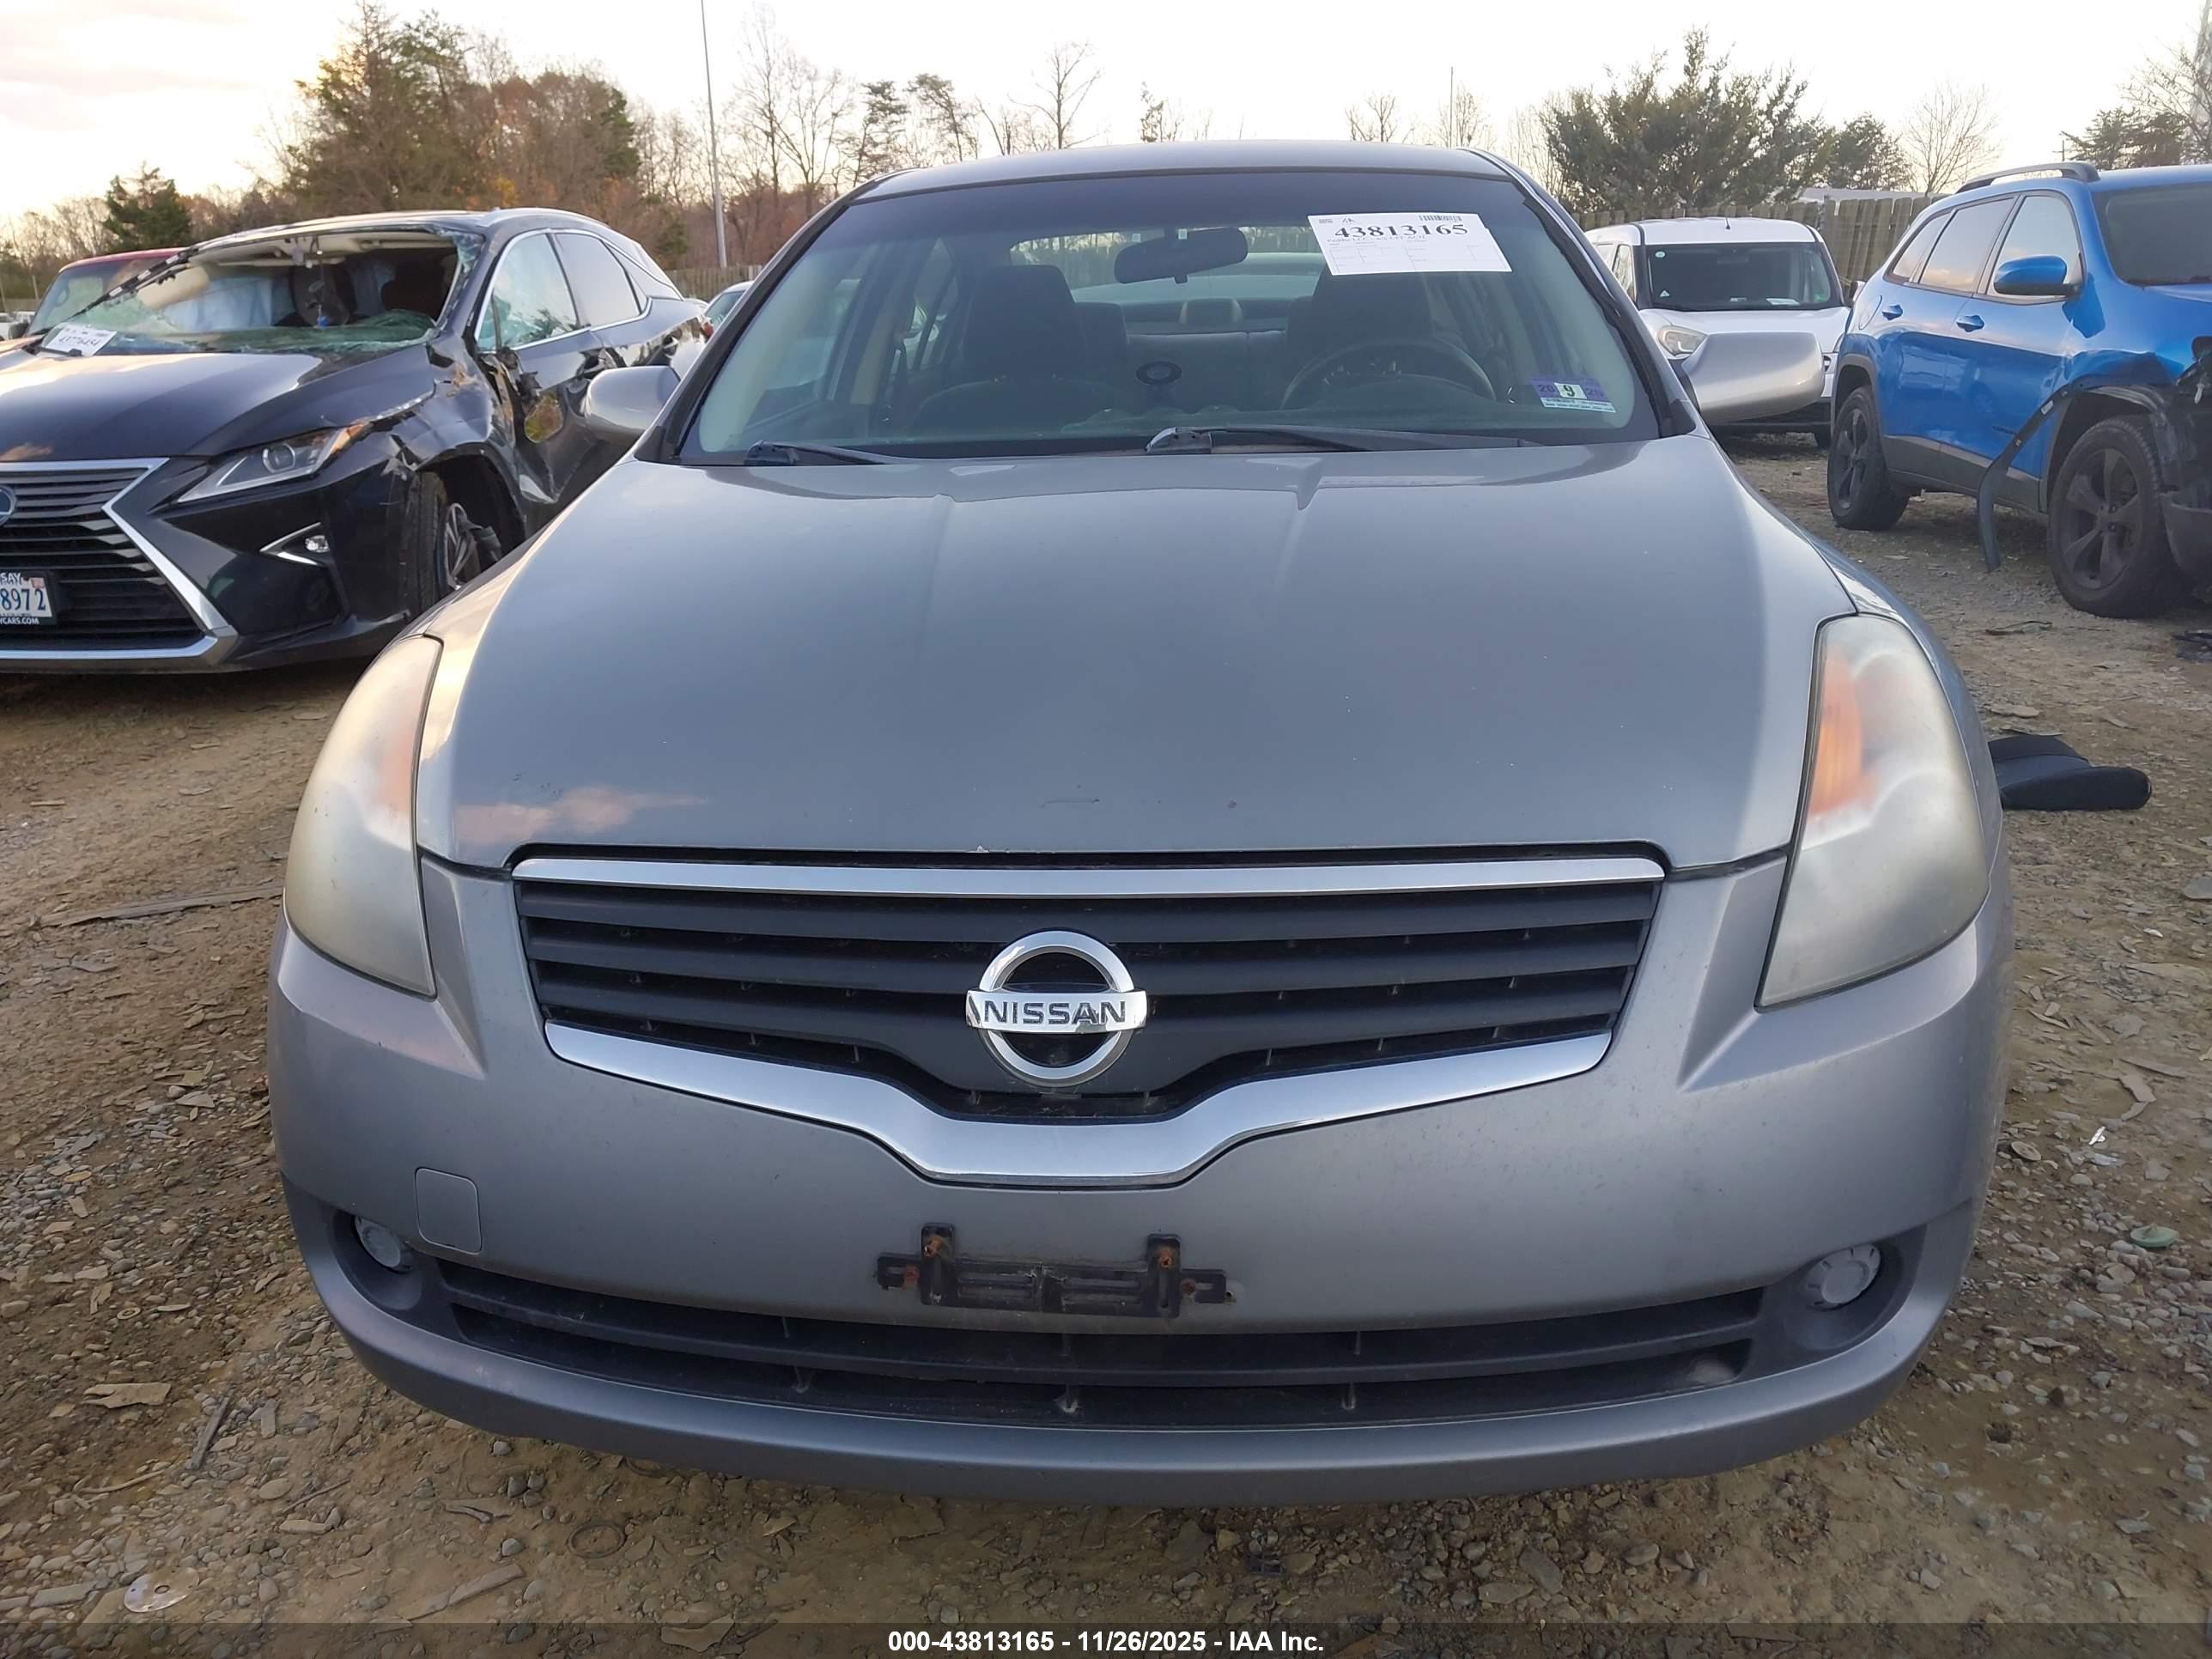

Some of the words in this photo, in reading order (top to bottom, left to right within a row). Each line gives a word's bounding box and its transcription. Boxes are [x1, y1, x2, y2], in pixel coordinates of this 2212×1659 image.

[1334, 223, 1468, 238] 43813165
[1563, 384, 1576, 398] 9
[0, 587, 46, 611] 8972
[983, 1000, 1127, 1025] NISSAN
